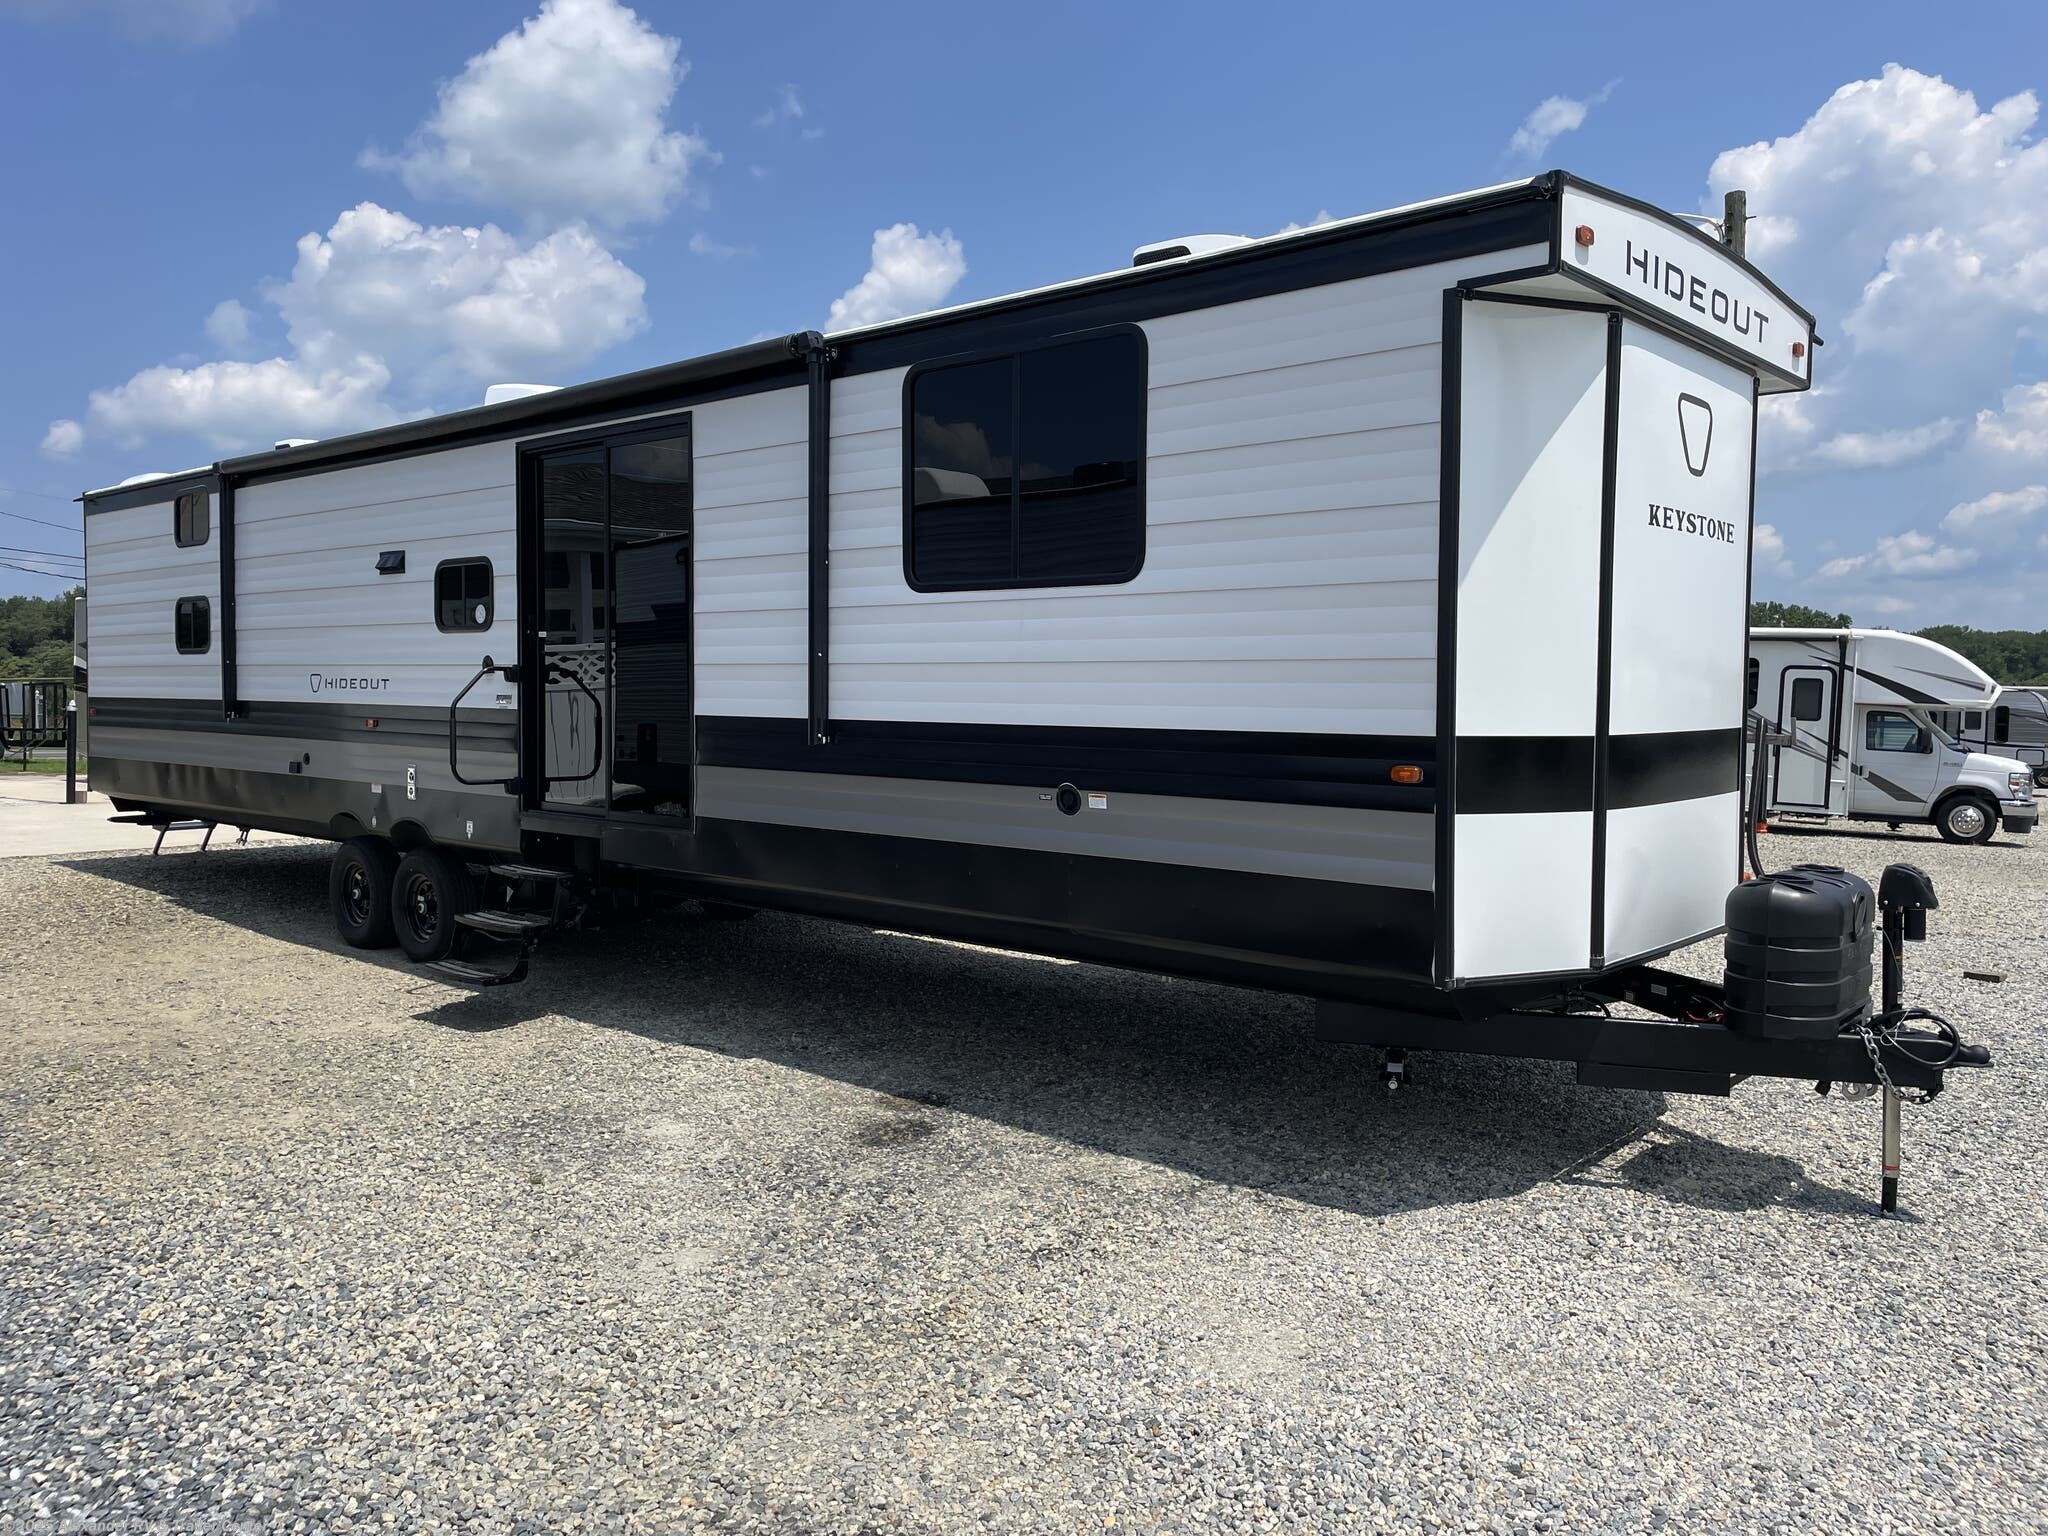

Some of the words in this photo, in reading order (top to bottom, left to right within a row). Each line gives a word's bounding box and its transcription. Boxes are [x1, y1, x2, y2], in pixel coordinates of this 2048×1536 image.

[1626, 240, 1769, 343] HIDEOUT
[1648, 504, 1735, 544] KEYSTONE
[324, 678, 390, 690] HIDEOUT
